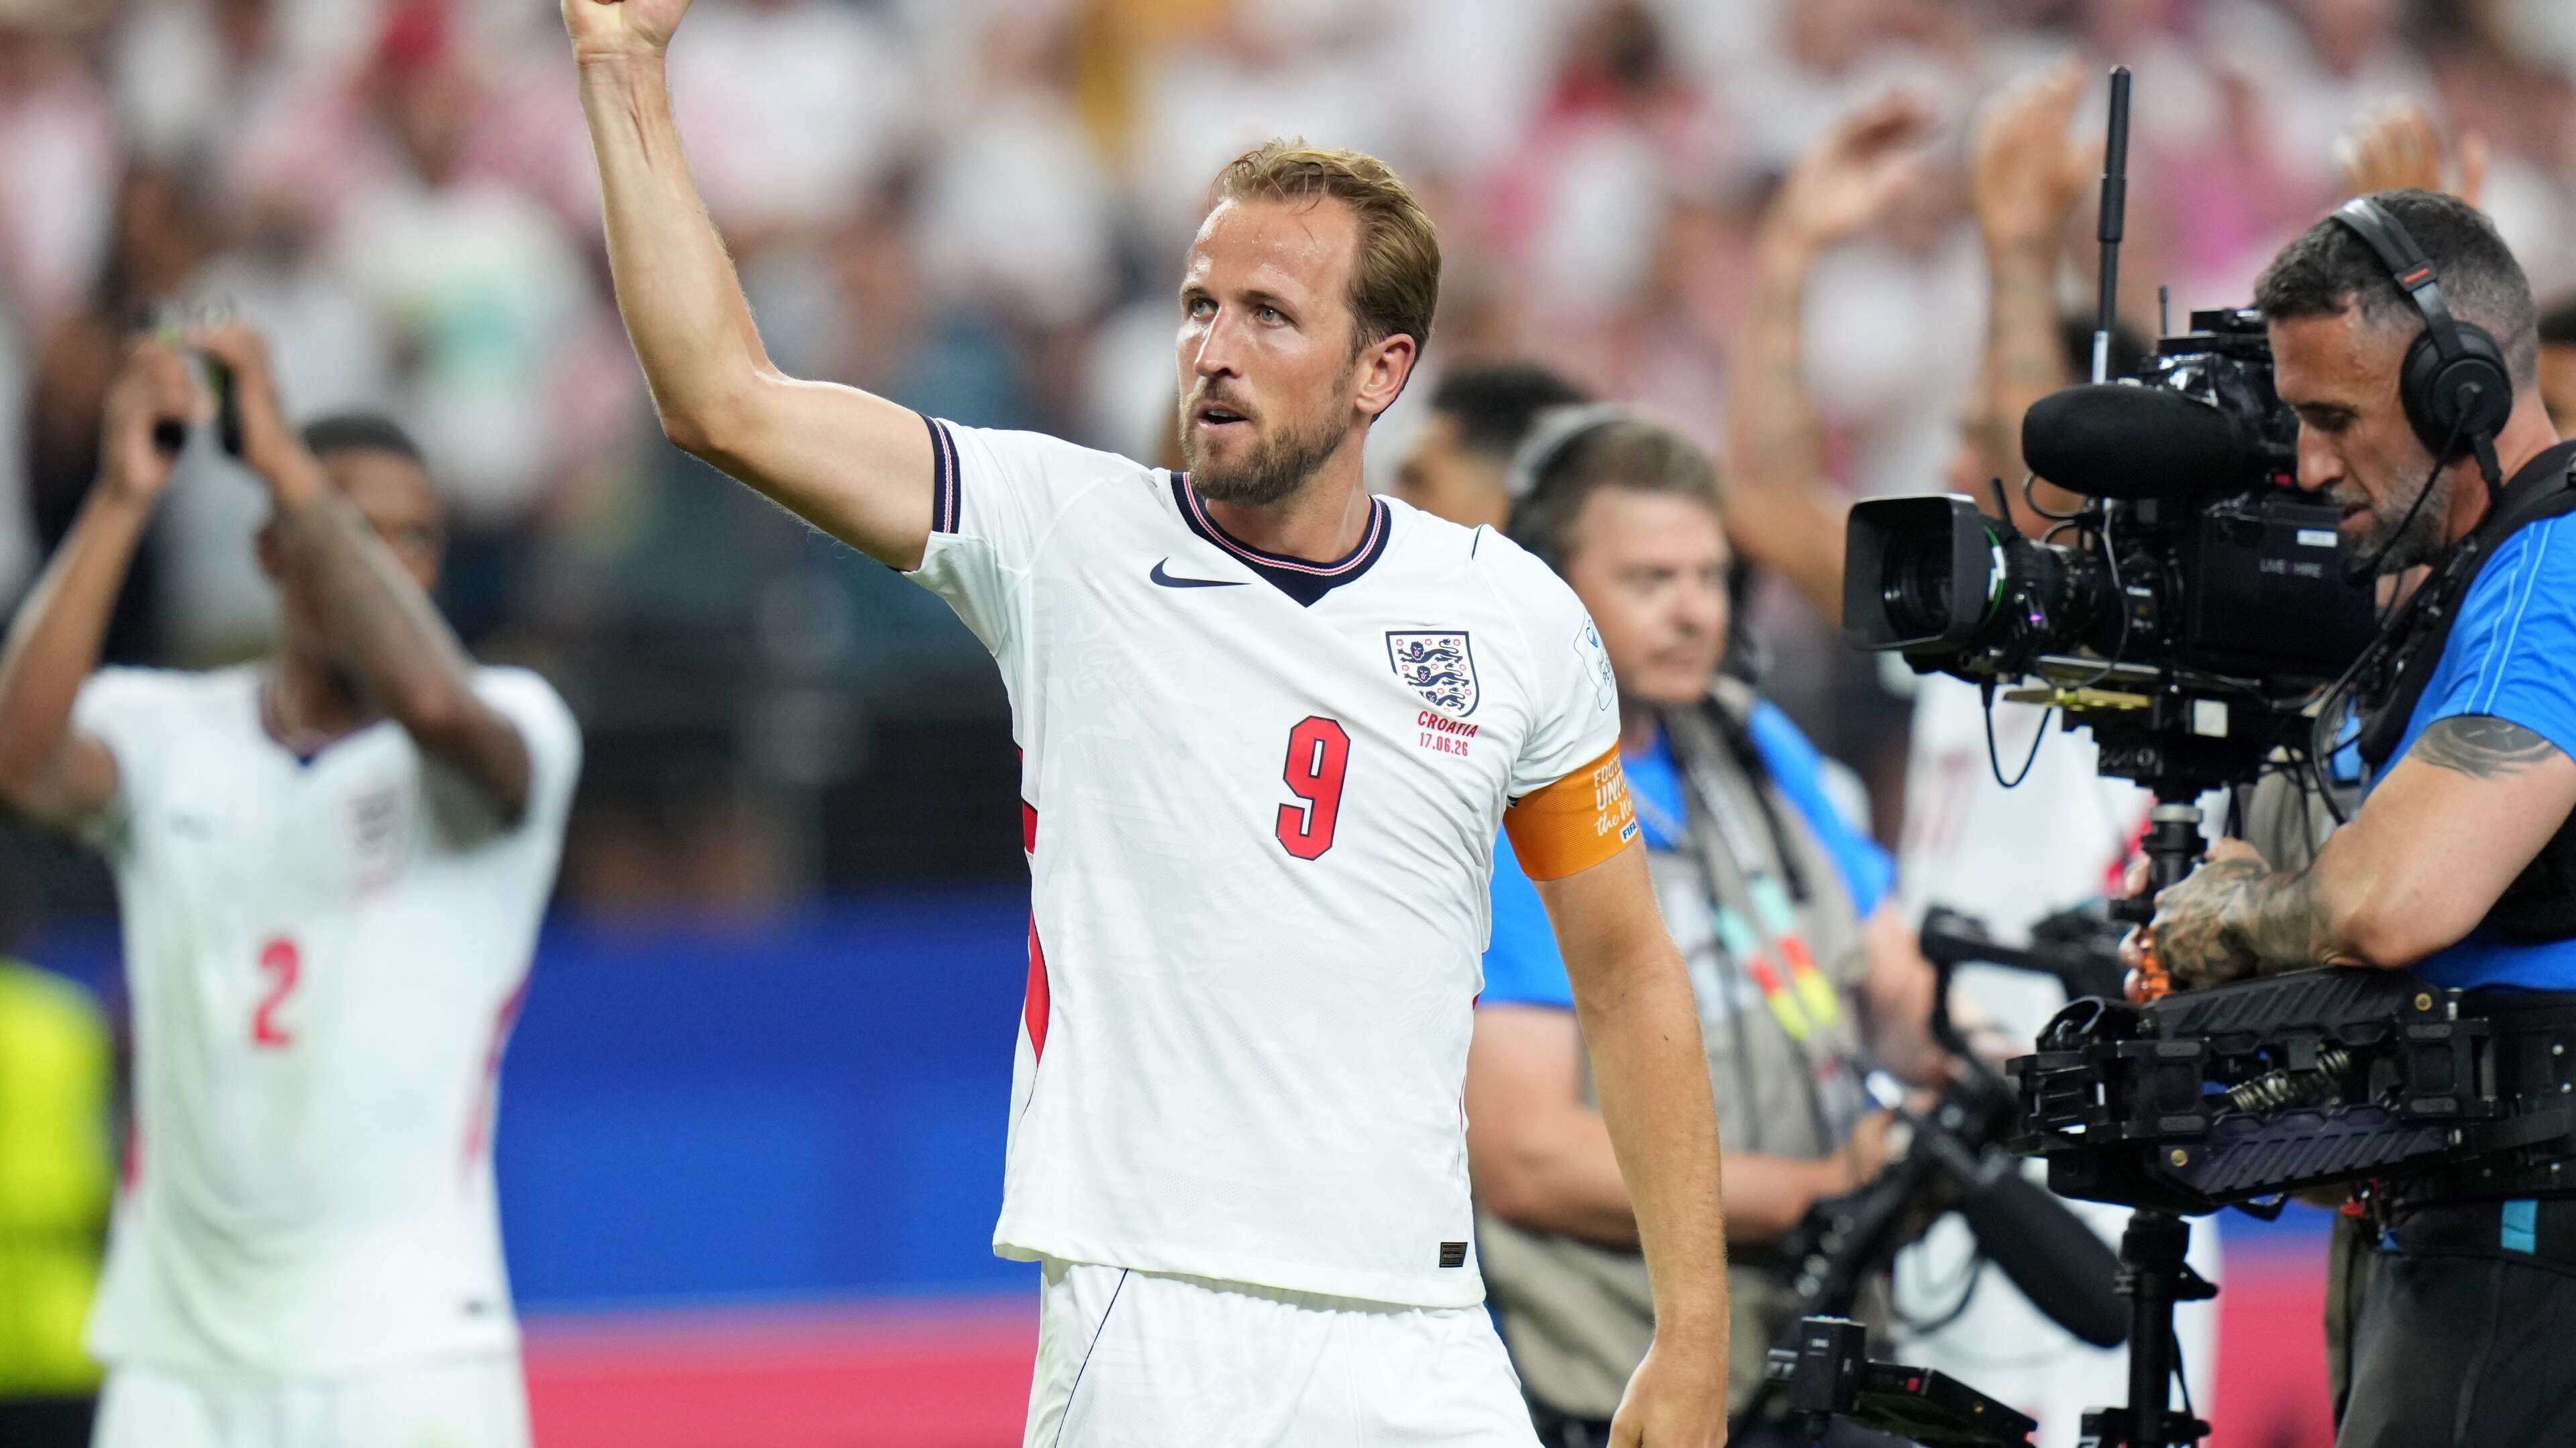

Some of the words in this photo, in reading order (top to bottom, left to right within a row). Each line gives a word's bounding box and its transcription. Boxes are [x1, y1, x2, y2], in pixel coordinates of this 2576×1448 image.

[1417, 710, 1479, 738] CROATIA
[1419, 732, 1468, 757] 17.06.26
[1275, 715, 1351, 860] 9
[1596, 767, 1626, 811] UNIT
[1593, 811, 1619, 837] the
[1622, 821, 1637, 840] FIFA
[252, 936, 299, 1049] 2
